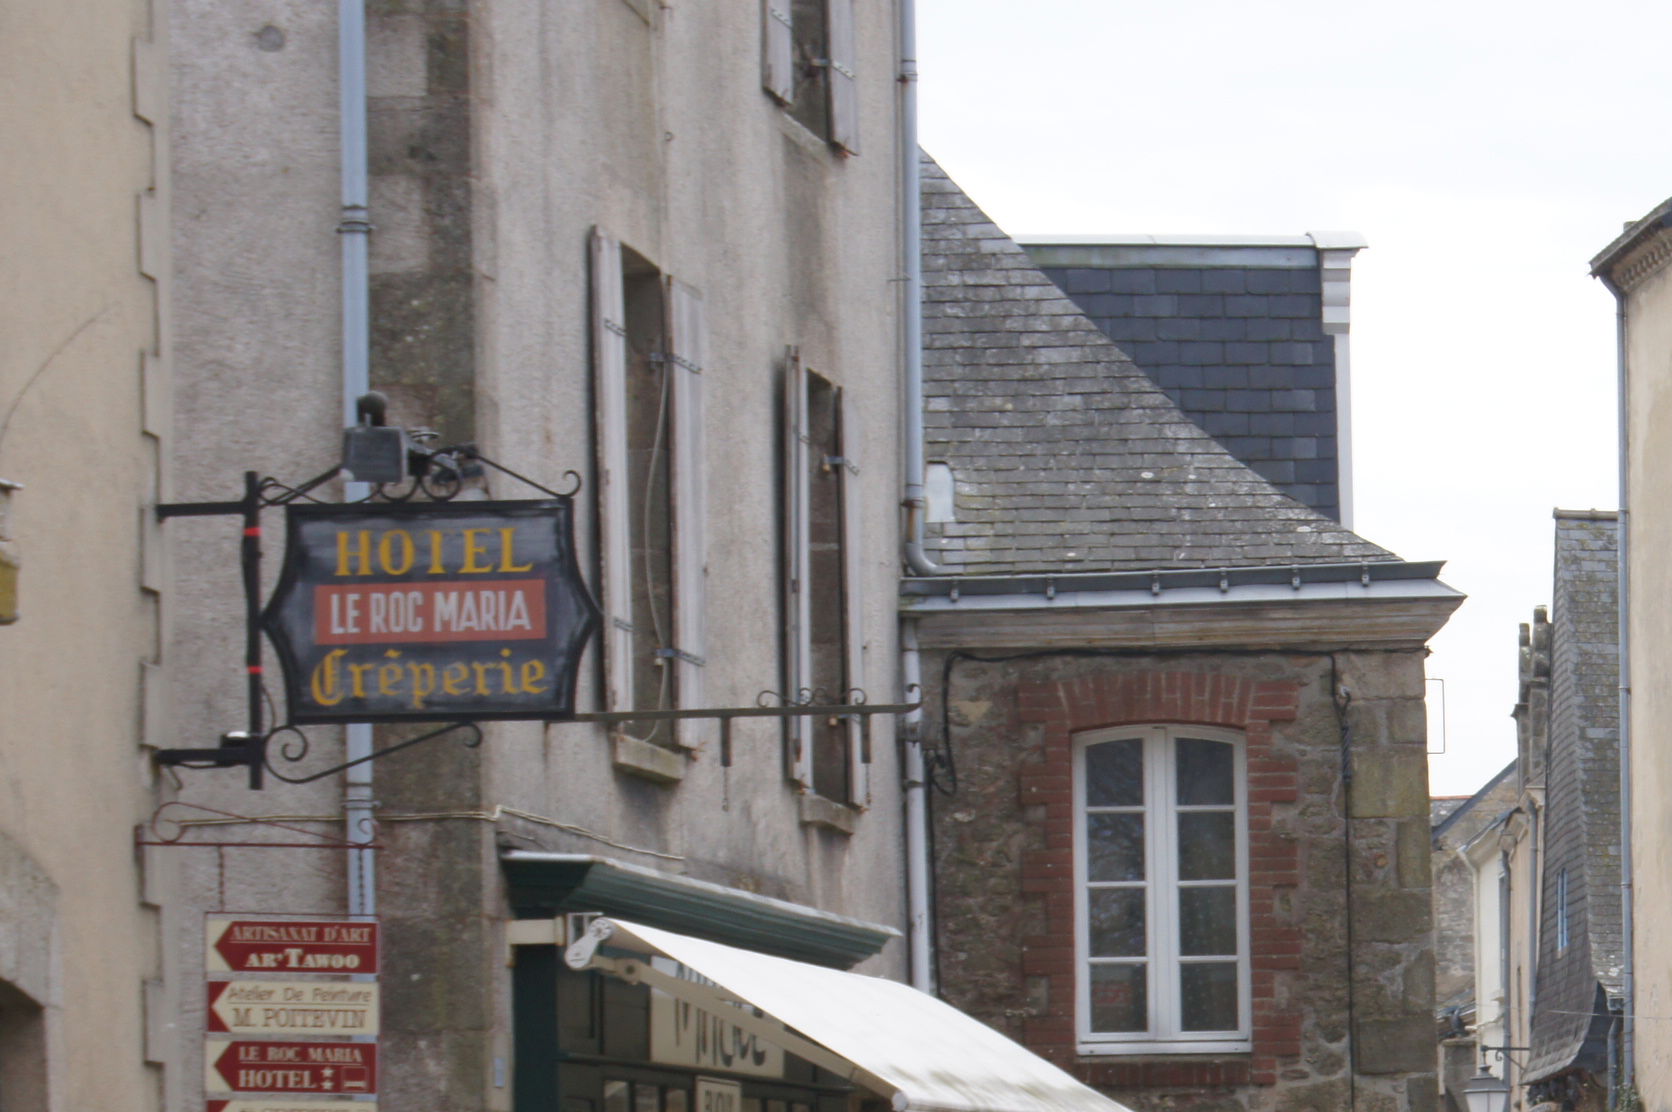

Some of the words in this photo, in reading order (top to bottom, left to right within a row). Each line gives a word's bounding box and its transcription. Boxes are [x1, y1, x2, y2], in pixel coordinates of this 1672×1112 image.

[334, 527, 533, 576] HOTEL
[330, 593, 362, 635] LE
[369, 591, 424, 634] ROC
[433, 590, 532, 632] MARIA
[310, 648, 549, 710] Crêperie
[323, 927, 371, 943] D'ART
[228, 986, 274, 1001] Atelier
[283, 987, 304, 1002] De
[312, 988, 373, 1003] Peinture
[232, 1007, 257, 1028] M.
[262, 1008, 367, 1029] POITEVIN
[239, 1046, 261, 1062] LE
[267, 1047, 300, 1063] ROC
[308, 1048, 363, 1064] MARIA
[239, 1069, 317, 1089] HOTEL
